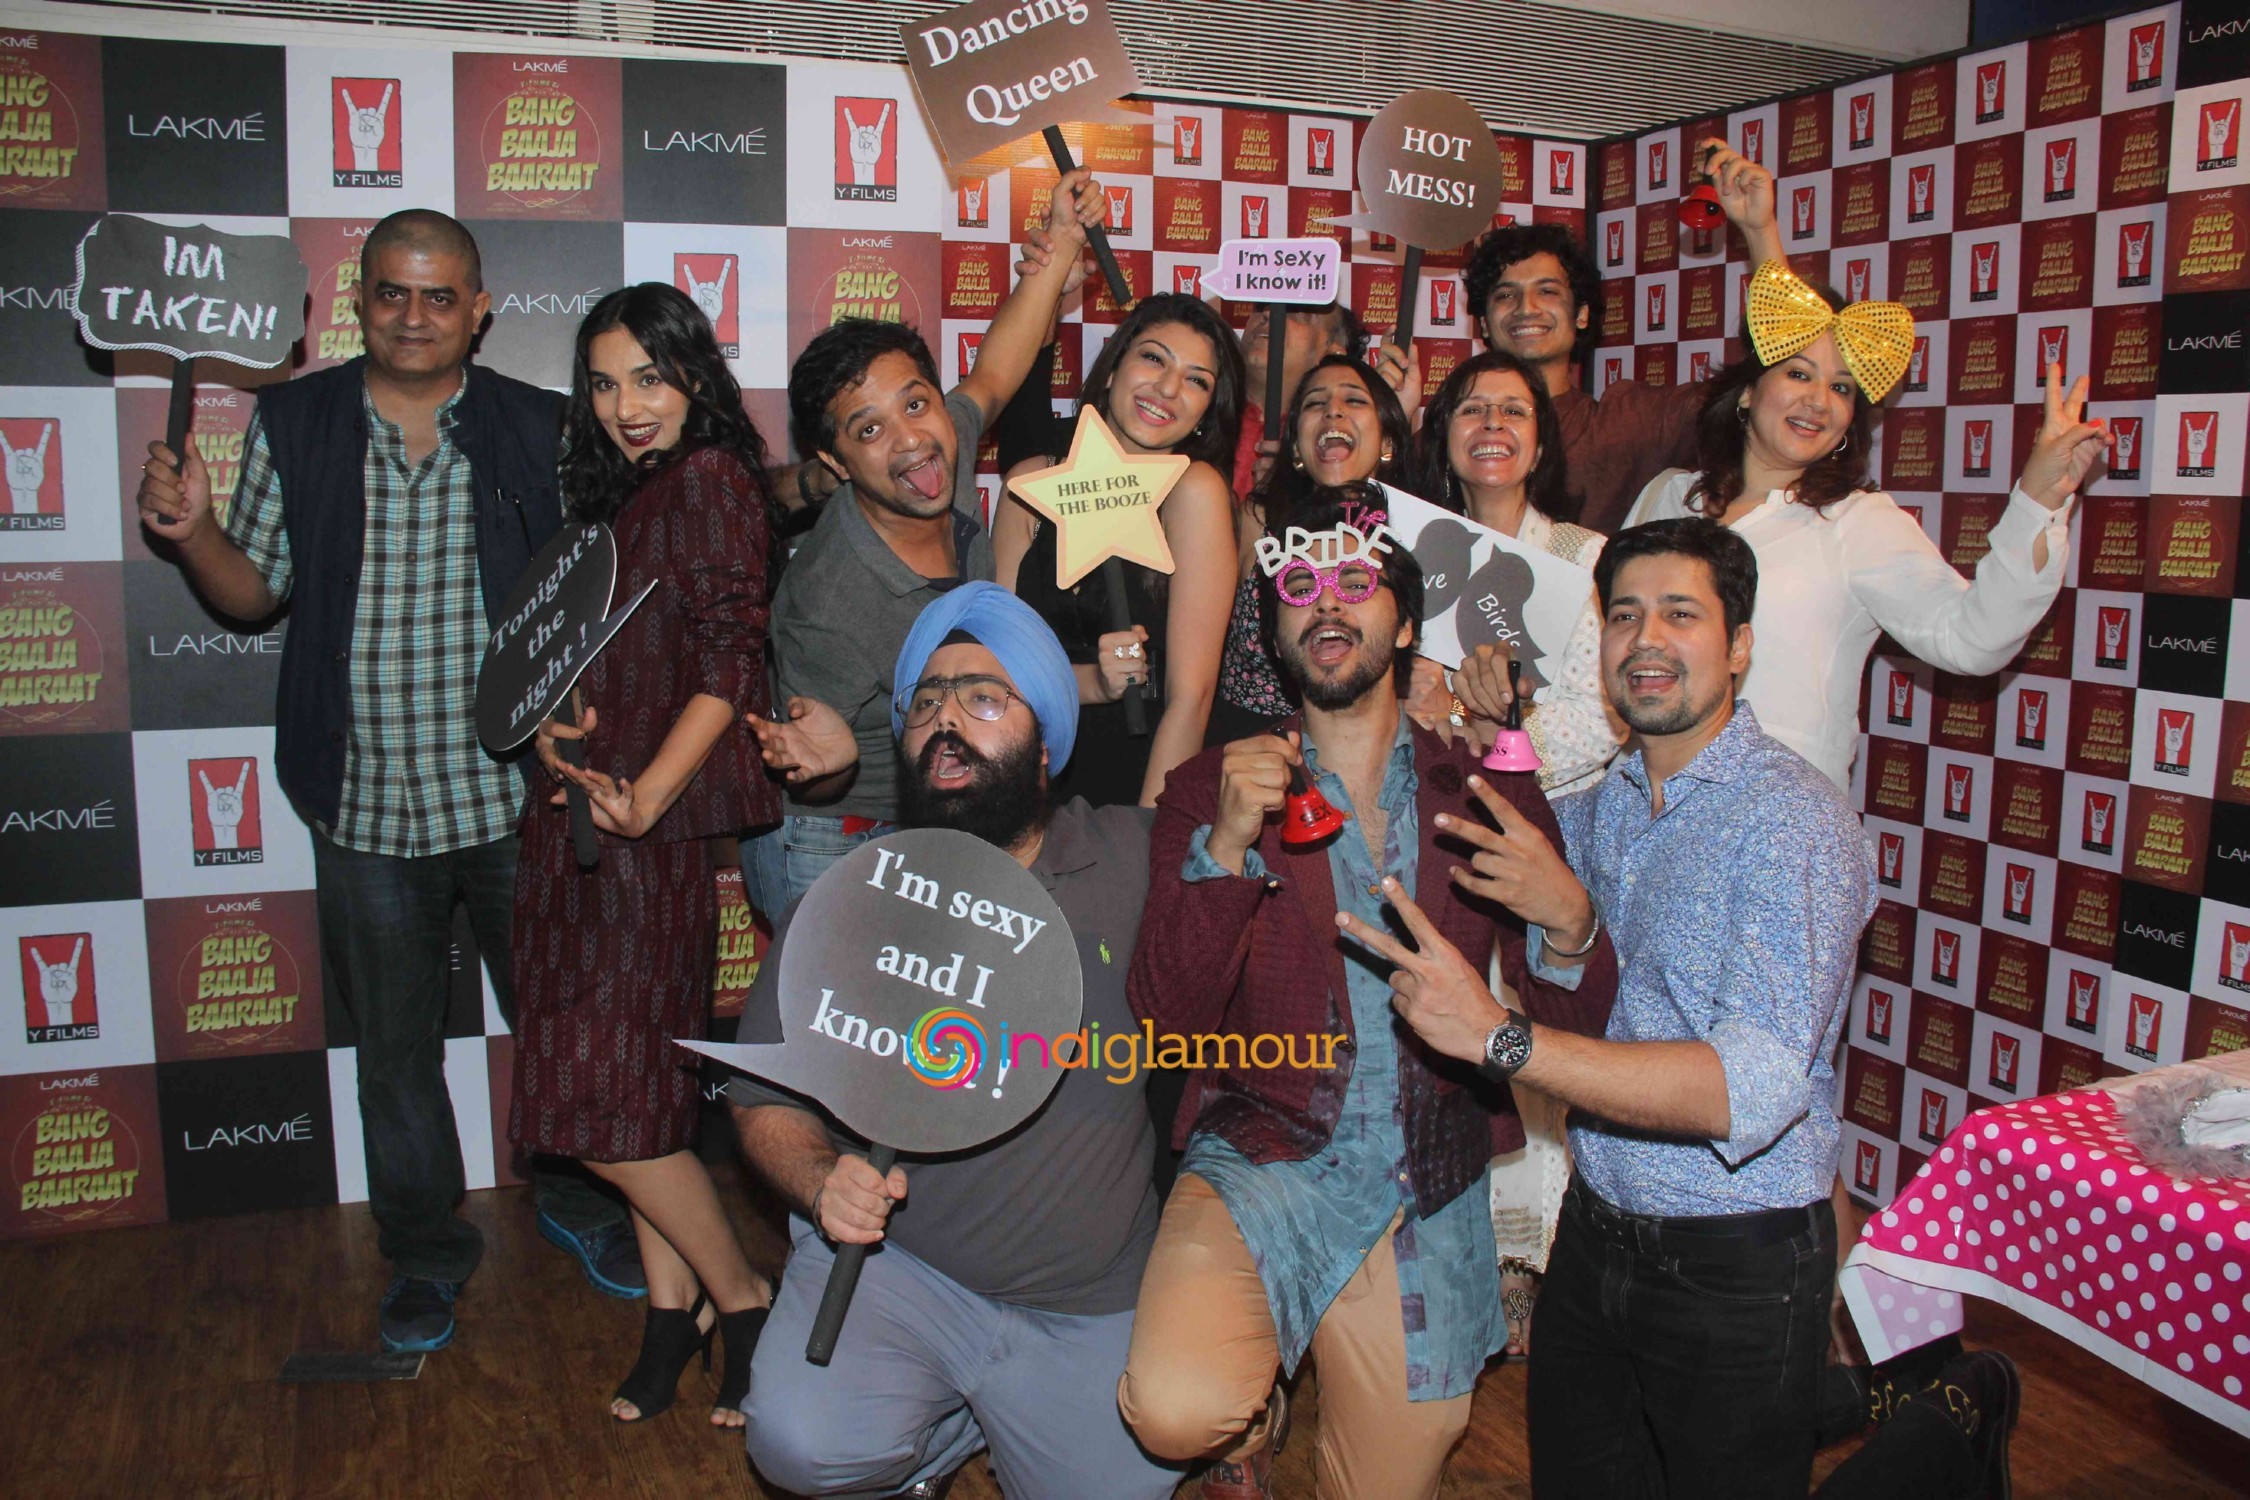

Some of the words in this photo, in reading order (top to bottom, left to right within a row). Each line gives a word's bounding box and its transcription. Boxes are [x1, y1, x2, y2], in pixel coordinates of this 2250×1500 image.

[920, 0, 1089, 67] Dancing
[2189, 19, 2250, 43] LAKM
[513, 60, 568, 73] LAKMÉ
[966, 56, 1099, 127] Queen
[505, 97, 576, 127] BANG
[129, 112, 265, 141] LAKMÉ
[1242, 129, 1270, 142] BANG
[500, 128, 577, 158] BAAJA
[644, 128, 767, 155] LAKMÉ
[1240, 143, 1270, 156] BAAJA
[1401, 126, 1472, 162] HOT
[1234, 158, 1278, 171] BAARAAT
[351, 174, 402, 186] FILMS
[487, 162, 599, 191] BAARAAT
[1384, 168, 1475, 208] MESS!
[851, 187, 896, 201] FILMS
[1174, 197, 1202, 210] BANG
[2199, 189, 2232, 201] LAKMÉ
[1171, 212, 1202, 225] BAAJA
[2192, 212, 2234, 235] BANG
[842, 236, 893, 248] LAKMÉ
[1166, 227, 1211, 240] BAARAAT
[2188, 233, 2234, 255] BAAJA
[958, 262, 989, 275] BANG
[1238, 249, 1268, 266] I'm
[1273, 249, 1326, 271] SeXy
[2179, 252, 2246, 276] BAARAAT
[835, 270, 900, 299] BANG
[956, 277, 990, 290] BAAJA
[1236, 273, 1241, 289] I
[1246, 273, 1301, 290] know
[1307, 274, 1326, 290] it!
[491, 287, 604, 314] AKMÉ
[950, 291, 999, 306] BAARAAT
[101, 286, 278, 340] TAKEN!
[2168, 330, 2242, 350] LAKMÉ
[1057, 479, 1102, 497] HERE
[1105, 474, 1139, 490] FOR
[1056, 499, 1091, 516] THE
[1095, 491, 1152, 511] BOOZE
[2179, 499, 2210, 507] LAKMÉ
[2172, 520, 2211, 539] BANG
[1254, 521, 1400, 578] BRIDE
[2167, 539, 2210, 558] BAAJA
[3, 568, 63, 581] LAKMÉ
[2159, 559, 2222, 578] BAARAAT
[492, 523, 599, 656] Tonight's
[0, 606, 74, 638] BANG
[527, 608, 565, 660] the
[2148, 635, 2217, 654] LAKMÉ
[0, 640, 77, 672] BAAJA
[2155, 793, 2184, 805] LAKMÉ
[1, 800, 116, 833] AKMÉ
[2148, 812, 2184, 834] BANG
[2144, 832, 2184, 855] BAAJA
[213, 850, 262, 863] FILMS
[2134, 850, 2192, 876] BAARAAT
[206, 898, 262, 913] LAKMÉ
[867, 848, 942, 910] I'm
[948, 888, 1047, 954] sexy
[2123, 921, 2186, 948] LAKMÉ
[201, 933, 272, 967] BANG
[198, 965, 276, 999] BAAJA
[876, 944, 965, 997] and
[966, 964, 995, 1008] I
[187, 994, 299, 1033] BAARAAT
[46, 1026, 98, 1039] FILMS
[40, 1073, 99, 1090] LAKMÉ
[36, 1109, 110, 1144] BANG
[184, 1113, 313, 1150] LAKMÉ
[33, 1140, 114, 1176] BAAJA
[20, 1169, 139, 1211] BAARAAT
